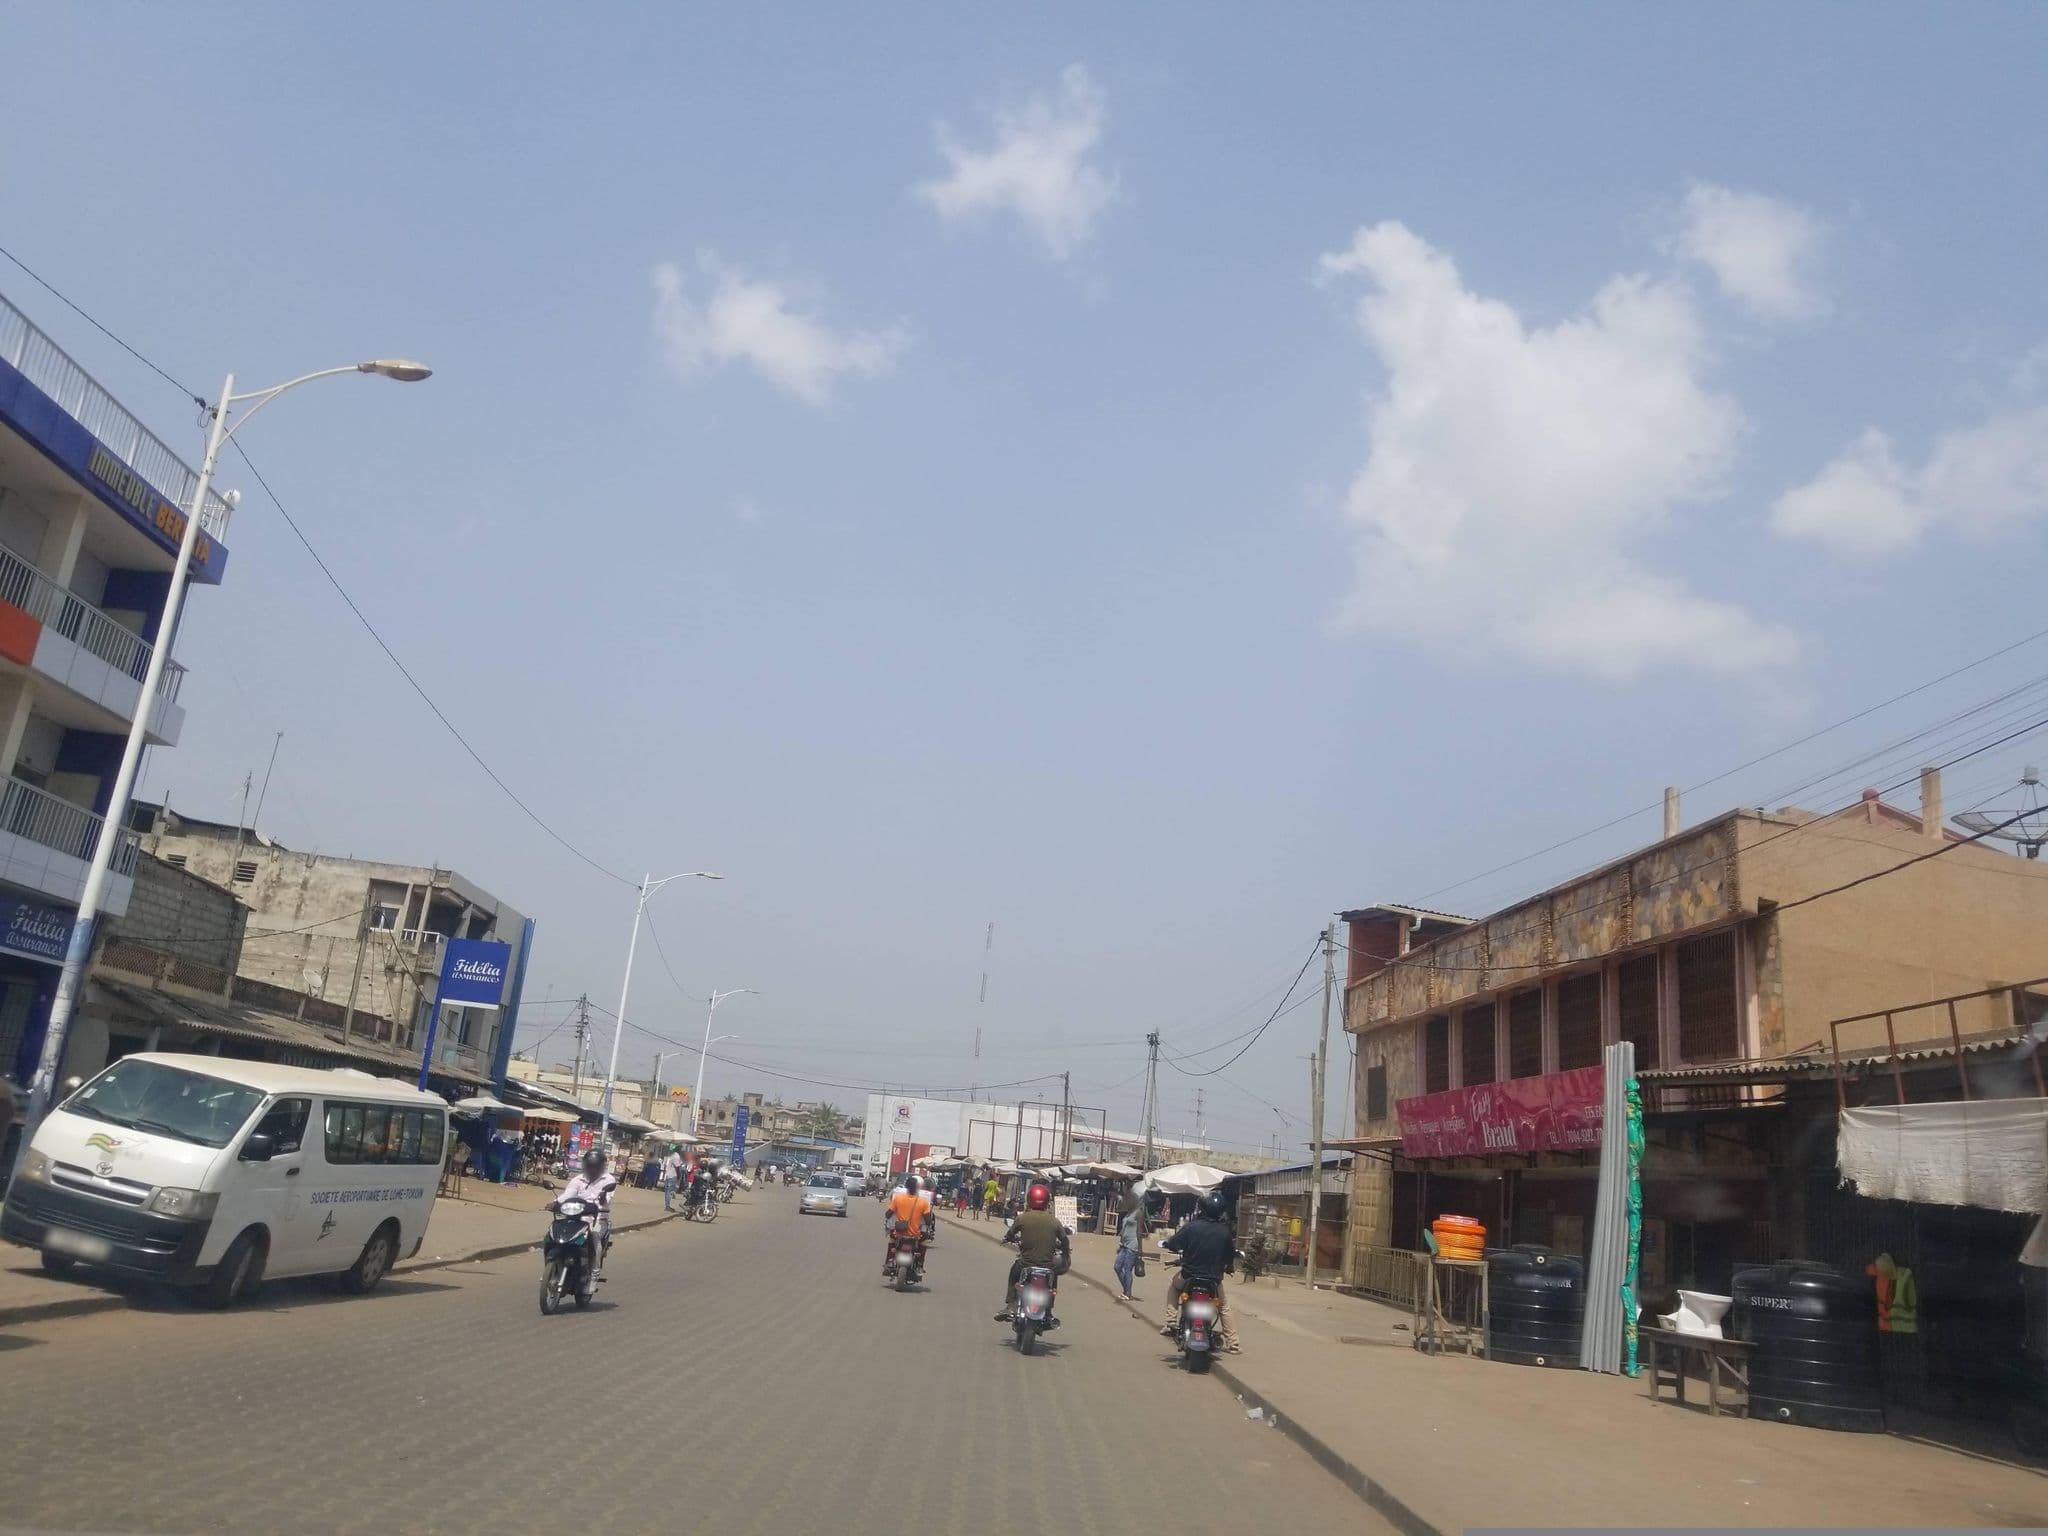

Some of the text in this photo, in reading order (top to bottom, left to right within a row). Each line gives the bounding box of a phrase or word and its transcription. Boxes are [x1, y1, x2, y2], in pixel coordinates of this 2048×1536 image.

[90, 450, 156, 520] IMMEUBLE
[454, 959, 501, 976] Fidélia
[1481, 1118, 1517, 1148] Braid
